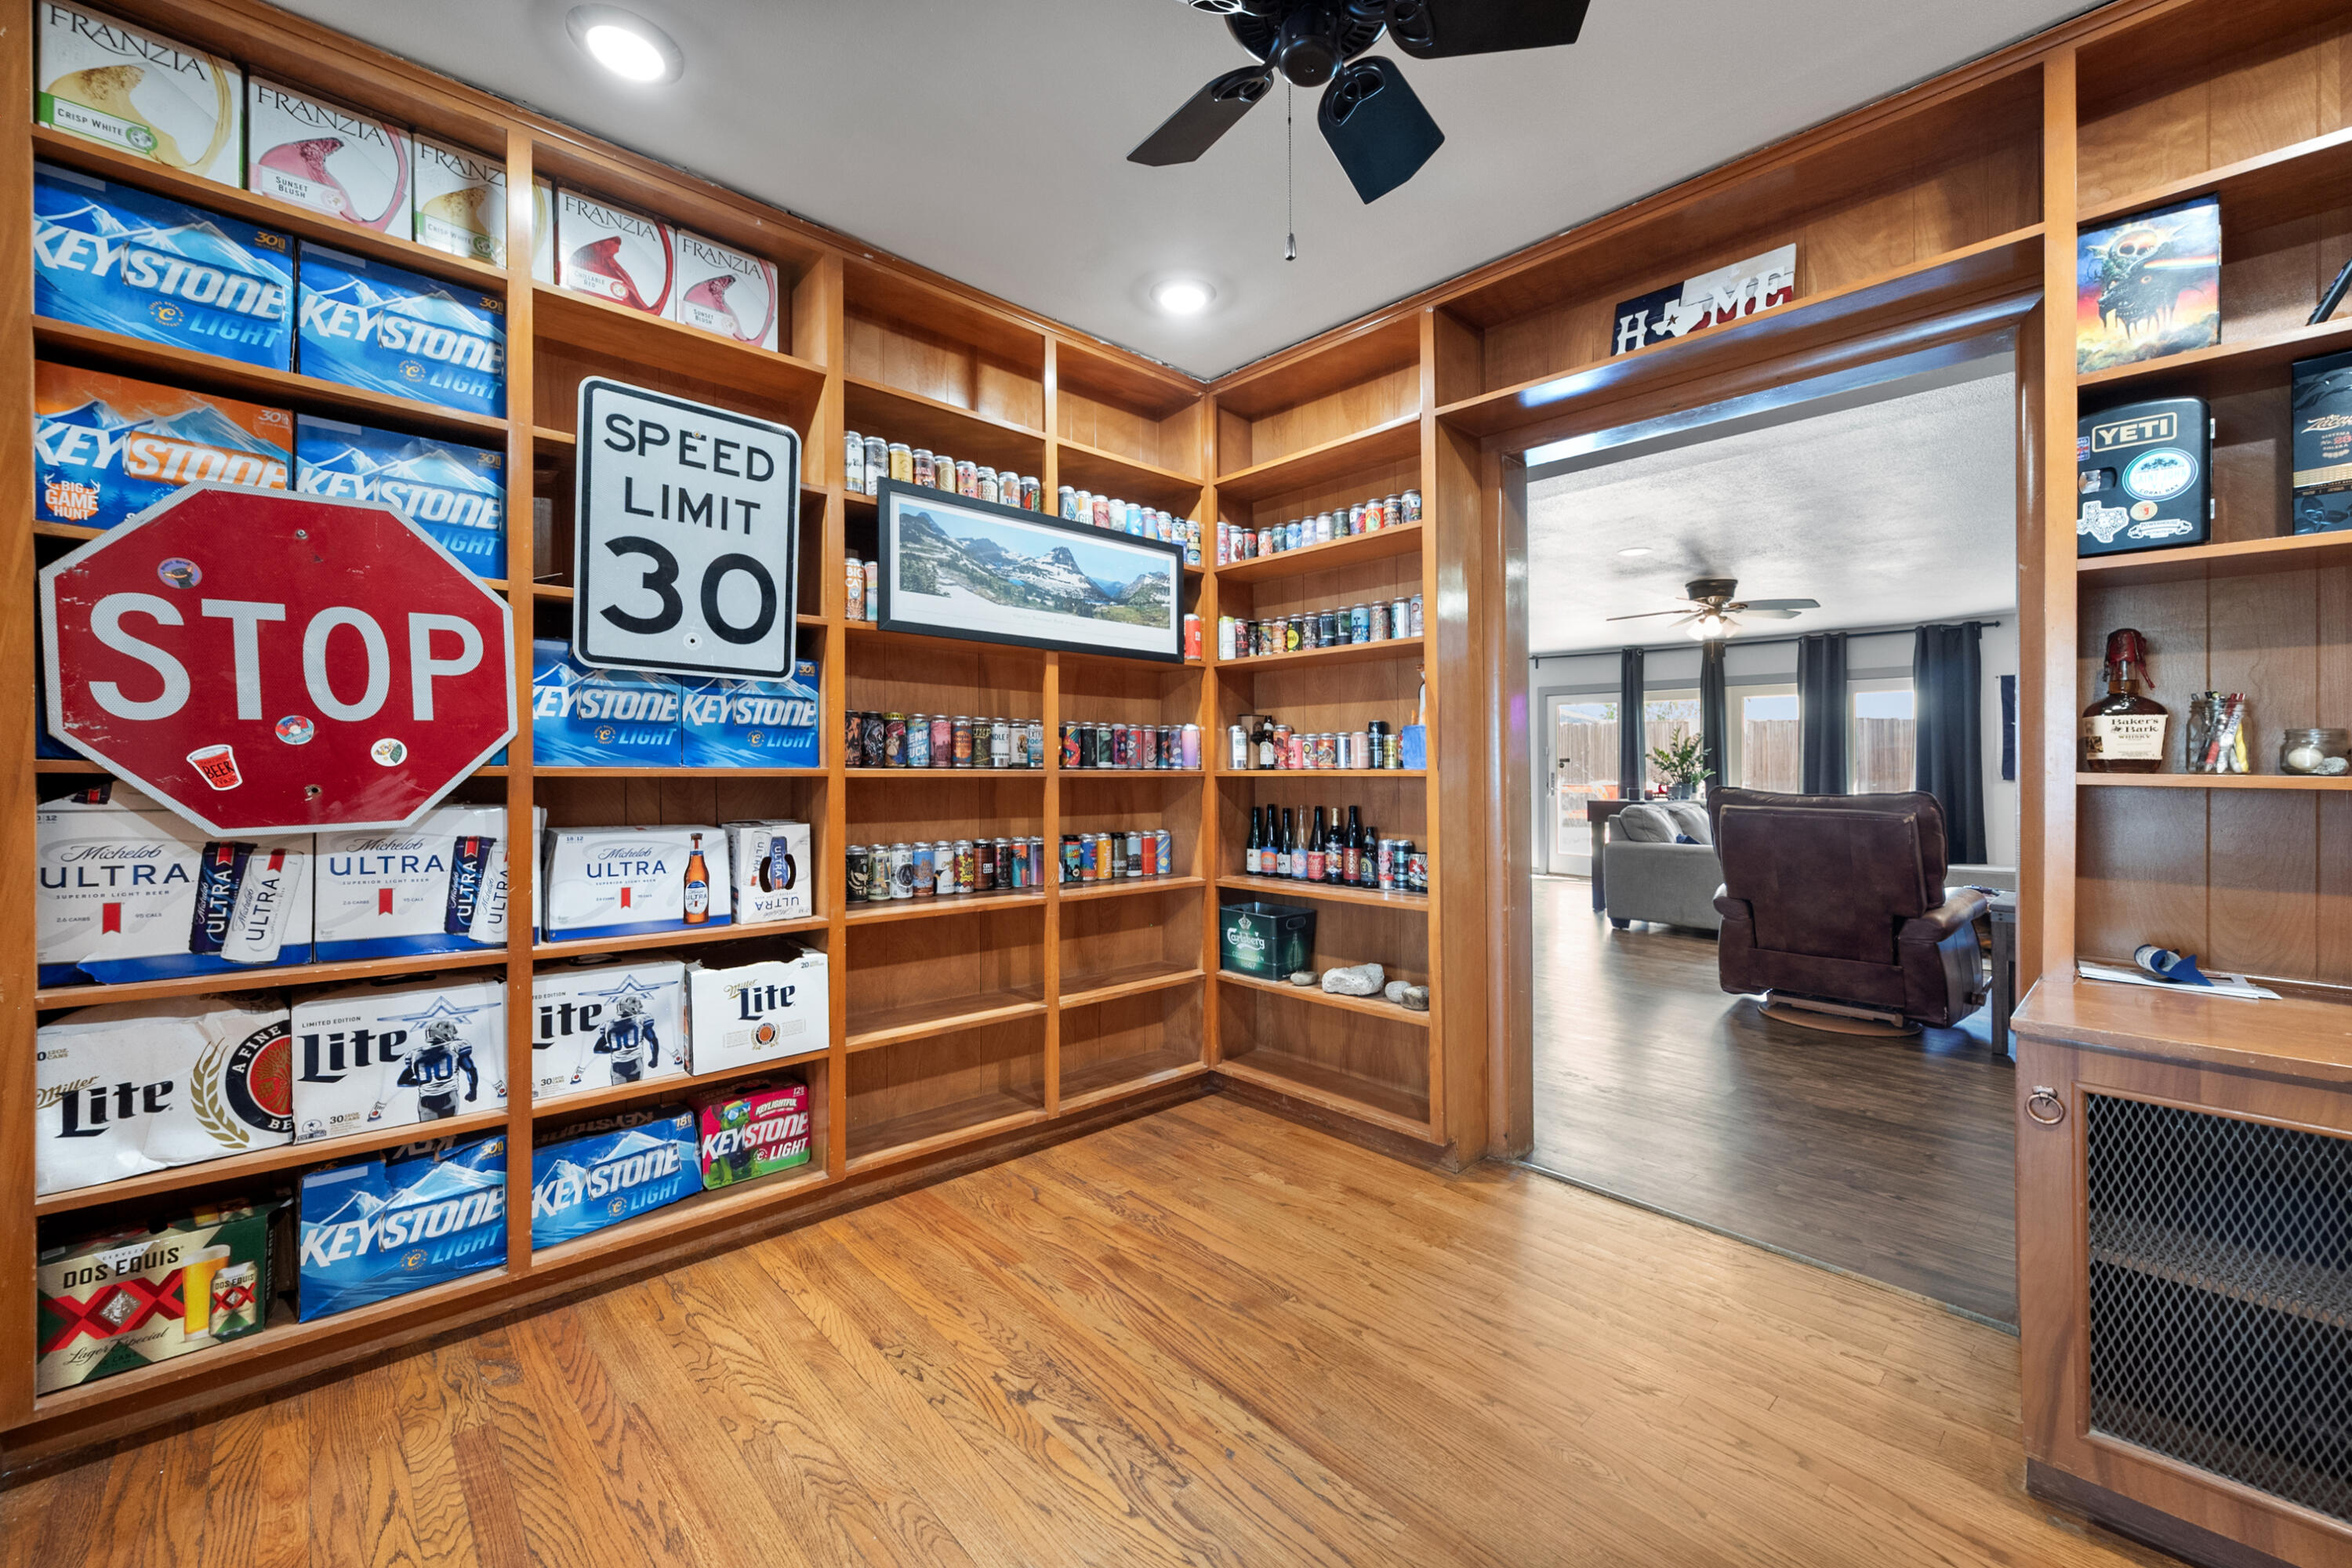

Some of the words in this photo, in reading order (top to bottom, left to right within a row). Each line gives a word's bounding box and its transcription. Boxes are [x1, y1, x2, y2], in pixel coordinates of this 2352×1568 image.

[50, 5, 208, 82] FRANZIA
[257, 85, 385, 147] FRANZIA
[275, 176, 308, 193] SUNSET
[278, 184, 307, 199] BLUSH
[564, 197, 656, 242] FRANZIA
[34, 220, 285, 322] KEYSTONE
[682, 238, 762, 280] FRANZIA
[189, 314, 283, 348] LIGHT
[299, 294, 504, 376] KEYSTONE
[430, 369, 502, 400] LIGHT
[603, 413, 775, 482] SPEED
[2098, 418, 2169, 445] YETI
[45, 488, 100, 512] GAME
[61, 480, 84, 495] BIG
[53, 505, 90, 521] HUNT
[624, 476, 760, 535] LIMIT
[600, 535, 777, 644] 30
[89, 591, 484, 723] STOP
[682, 693, 816, 728] KEYSTONE
[619, 728, 677, 746] LIGHT
[767, 731, 815, 748] LIGHT
[201, 761, 234, 779] BEER
[60, 844, 165, 862] Michelob
[346, 837, 423, 853] Michelob
[598, 847, 652, 860] Michelob
[751, 841, 765, 877] ULTRA
[773, 845, 782, 878] ULTRA
[41, 863, 191, 889] ULTRA
[329, 855, 445, 877] ULTRA
[586, 859, 667, 879] ULTRA
[196, 881, 210, 925] Michelob
[205, 869, 233, 934] ULTRA
[449, 871, 459, 909] Michelob
[457, 861, 477, 917] ULTRA
[754, 895, 800, 910] ULTRA
[234, 887, 255, 931] Michelob
[245, 878, 280, 942] ULTRA
[1227, 927, 1265, 951] Carlsberg
[724, 979, 758, 1000] Miller
[738, 984, 796, 1021] Lite
[302, 1020, 331, 1029] LIMITED
[238, 1025, 281, 1060] FINE
[297, 1029, 408, 1083] Lite
[54, 1081, 174, 1138] Lite
[329, 1115, 343, 1124] 30
[755, 1098, 797, 1116] KEYLIGHTFUL
[268, 1119, 292, 1131] BE
[702, 1111, 809, 1160] KEYSTONE
[769, 1137, 808, 1162] LIGHT
[532, 1143, 681, 1218] KEYSTONE
[630, 1176, 682, 1211] LIGHT
[299, 1184, 505, 1268] KEYSTONE
[432, 1224, 503, 1265] LIGHT
[64, 1264, 108, 1290] DOS
[115, 1247, 180, 1277] EQUIS
[215, 1279, 230, 1290] DOS
[231, 1273, 255, 1286] EQUIS
